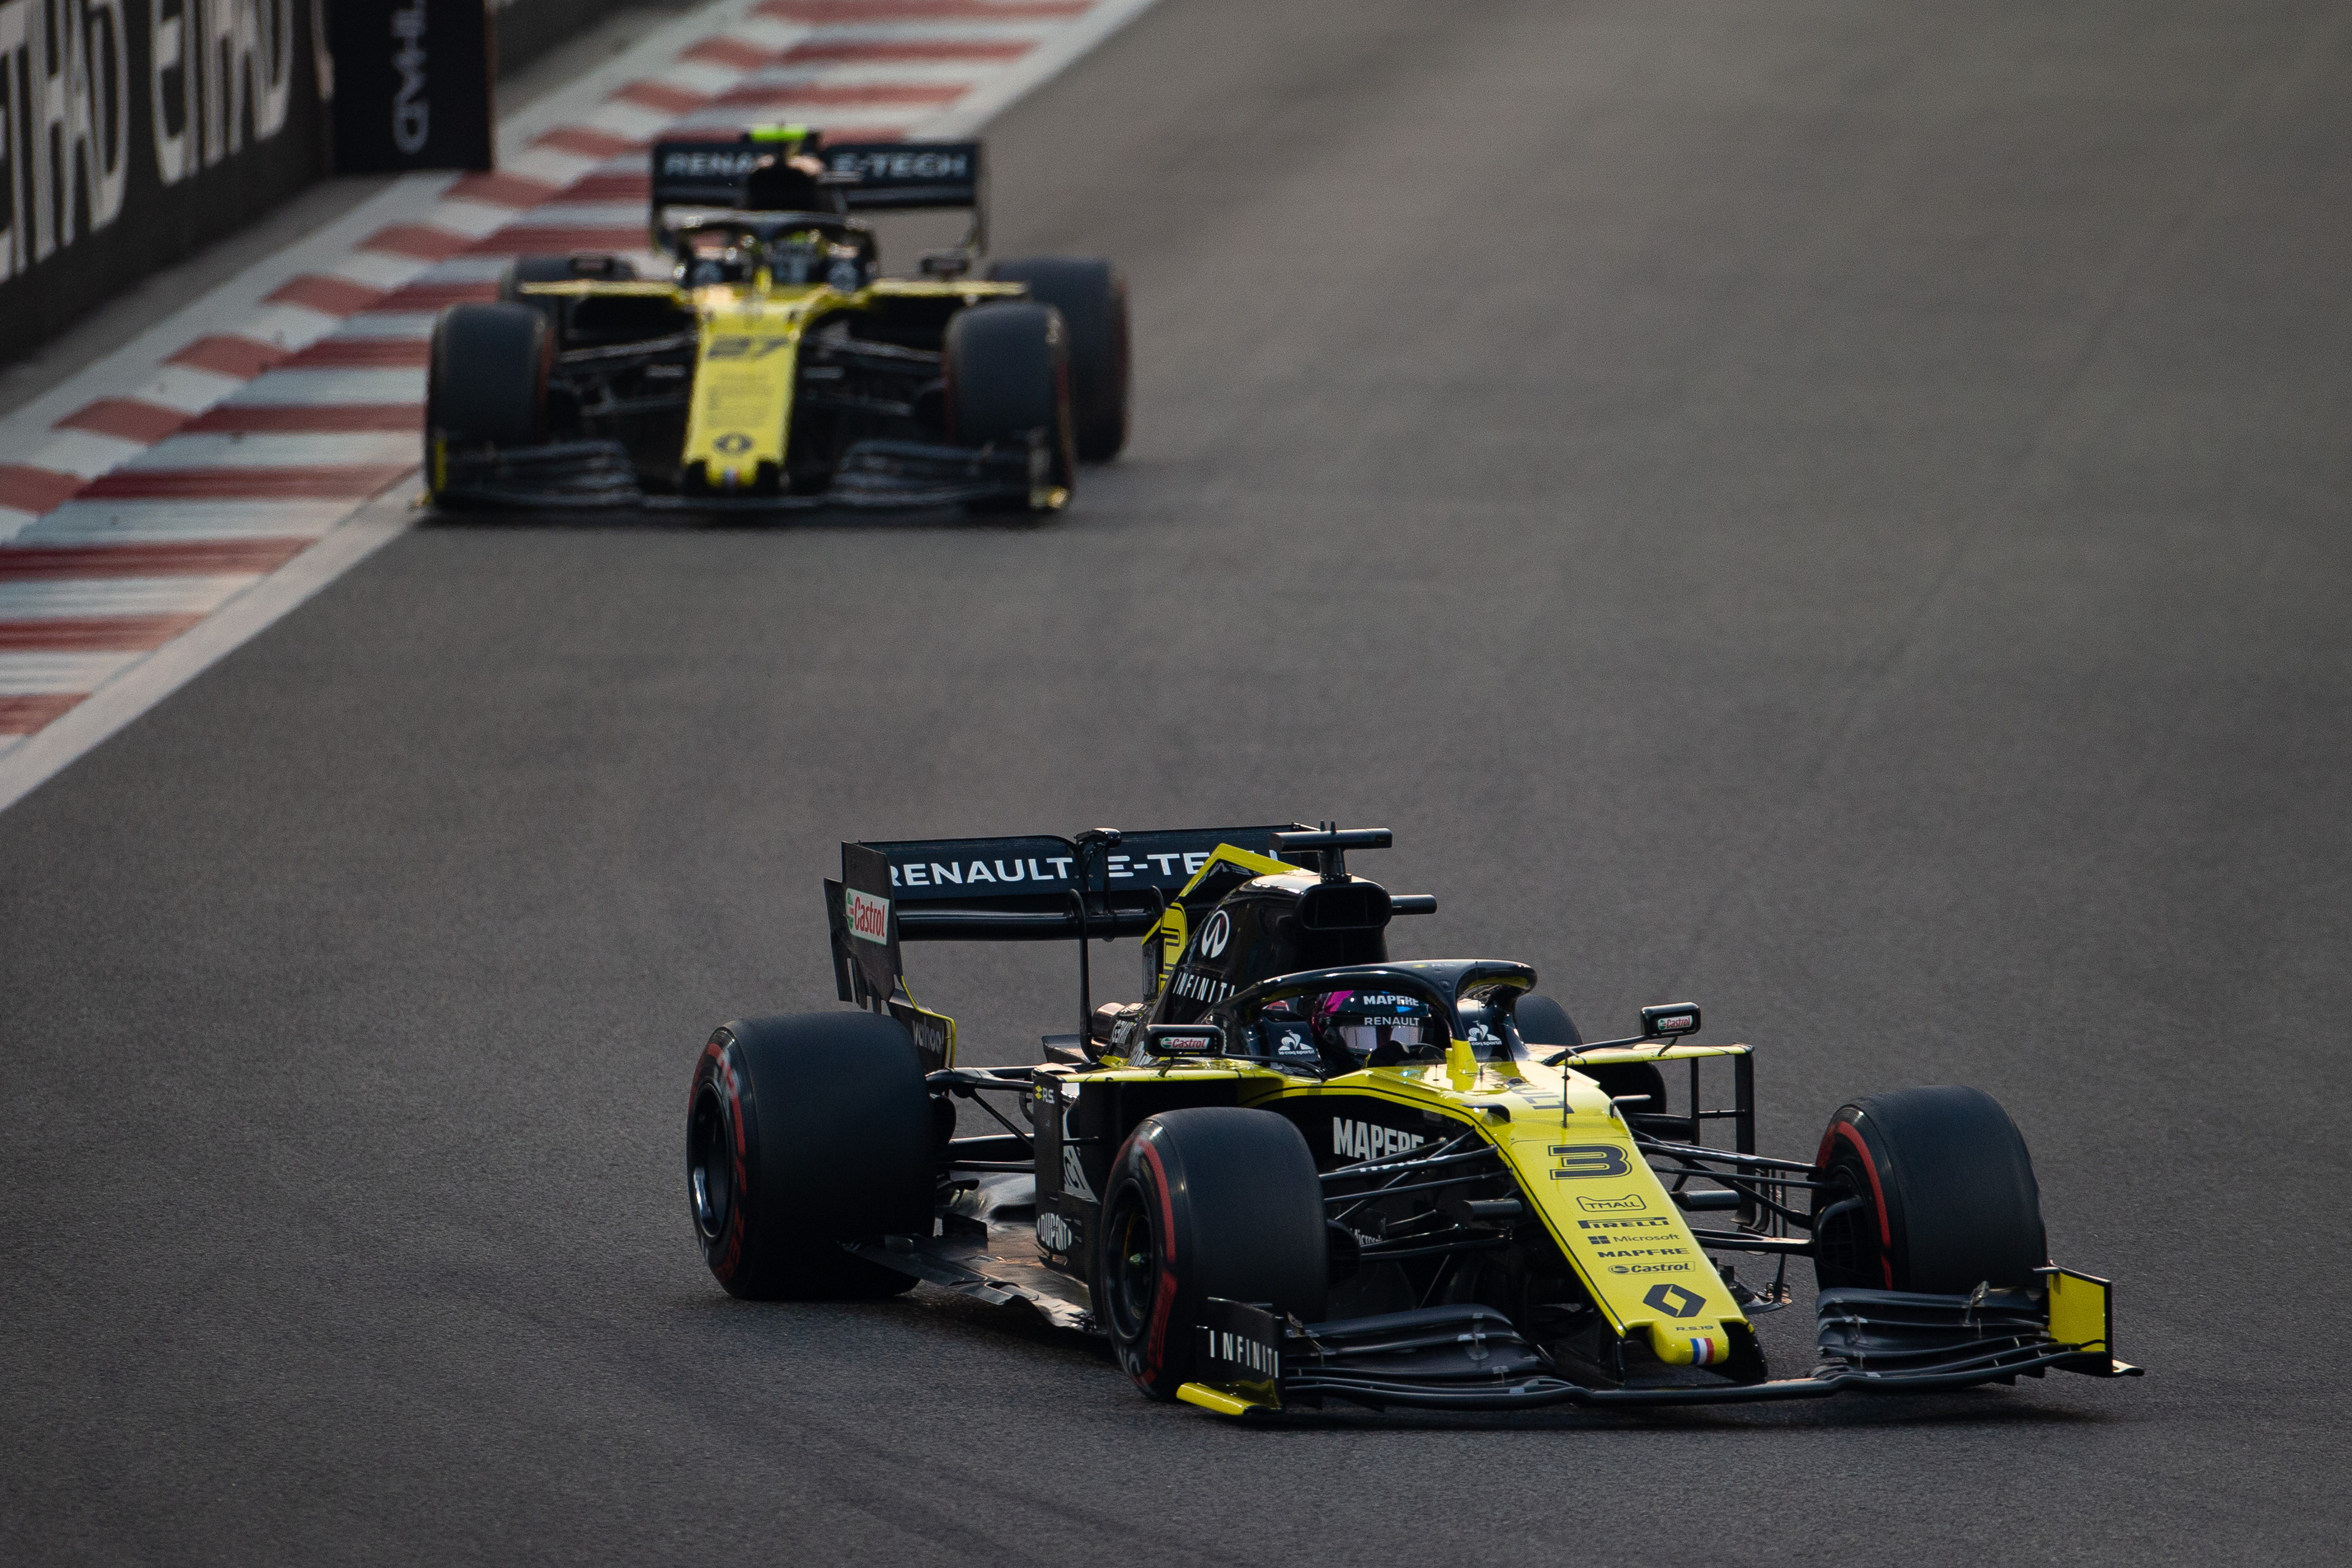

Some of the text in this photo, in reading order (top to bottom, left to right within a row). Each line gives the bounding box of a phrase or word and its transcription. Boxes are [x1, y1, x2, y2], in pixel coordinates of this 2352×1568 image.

[855, 896, 885, 937] Castrol
[1173, 972, 1236, 1002] INFINITI
[1364, 995, 1420, 1006] MAPFRE
[1364, 1017, 1420, 1026] RENAULT
[1667, 1017, 1690, 1029] Castrol
[1172, 1038, 1206, 1049] Castrol
[1548, 1143, 1633, 1180] 3
[1577, 1216, 1669, 1229] PIRELLI
[1613, 1233, 1680, 1242] Microsoft
[1597, 1248, 1690, 1258] MAPFRE
[1631, 1263, 1691, 1273] Castrol
[1209, 1330, 1279, 1379] INFINITI
